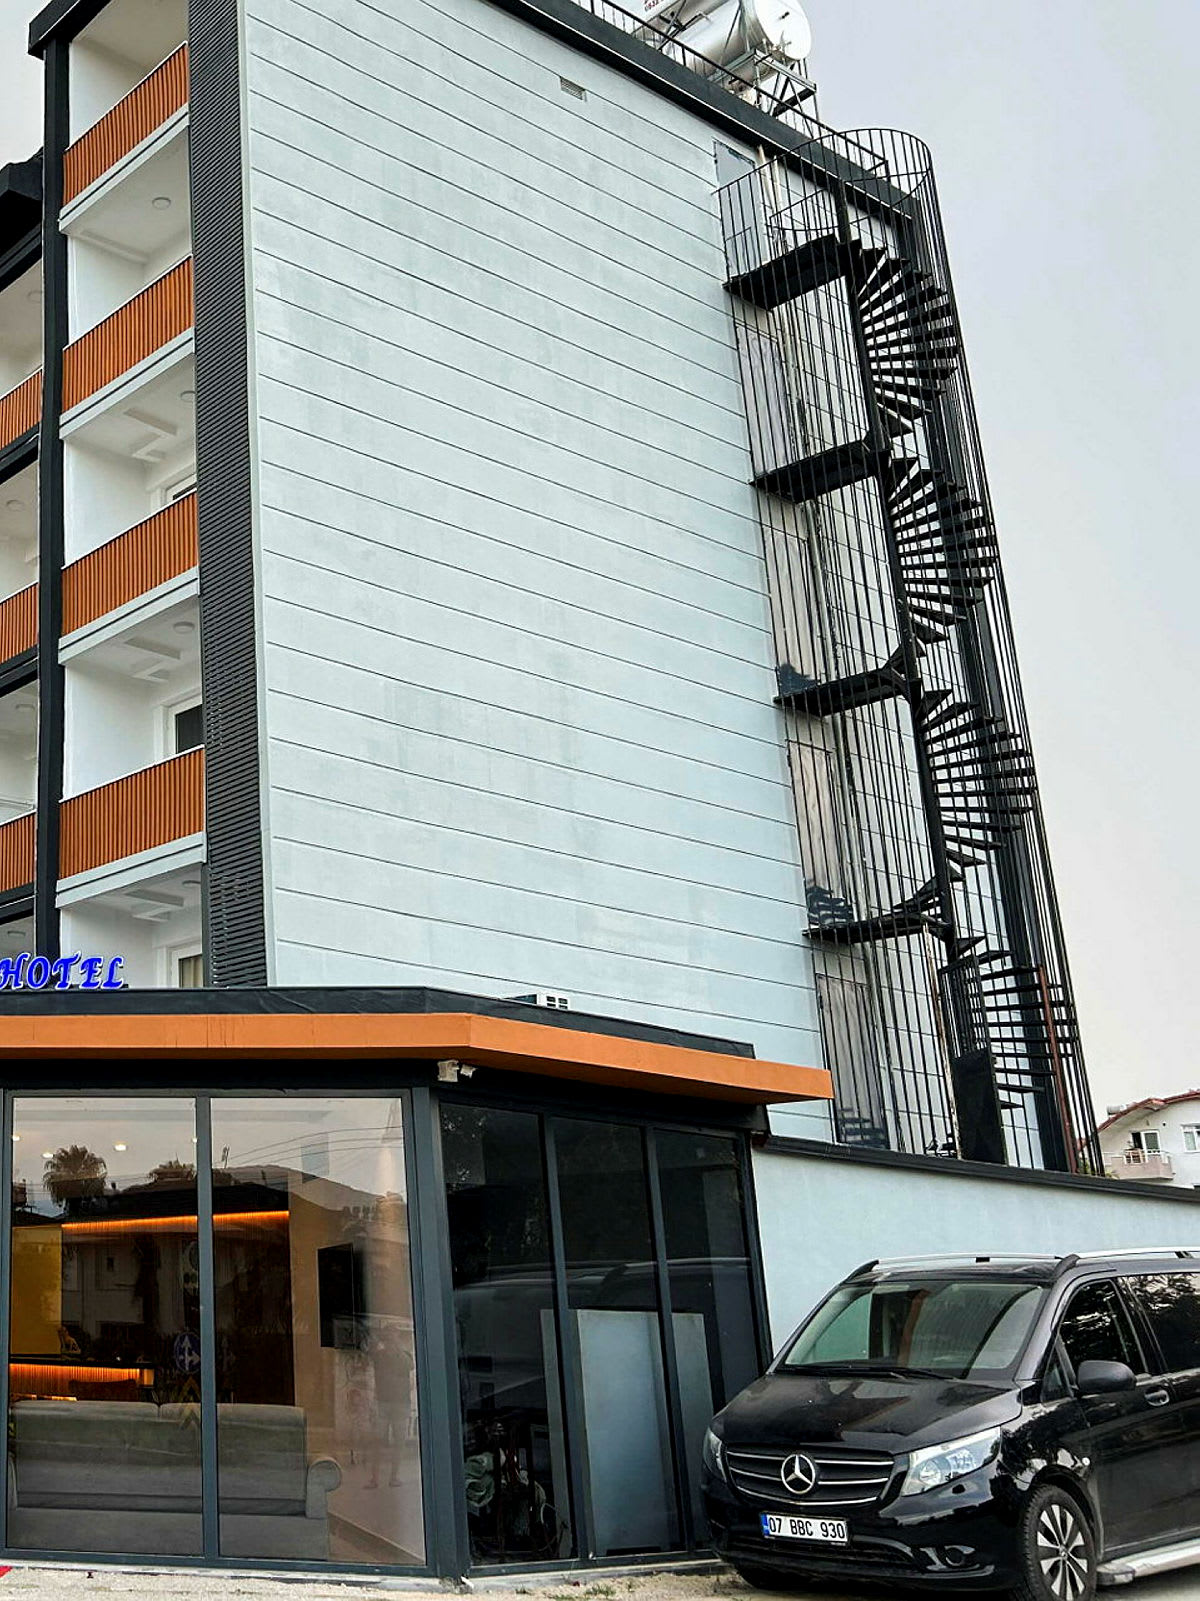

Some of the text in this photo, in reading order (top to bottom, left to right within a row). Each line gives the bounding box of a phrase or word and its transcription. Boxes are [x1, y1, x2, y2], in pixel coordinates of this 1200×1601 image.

[769, 1517, 845, 1539] 07 BBC 930
